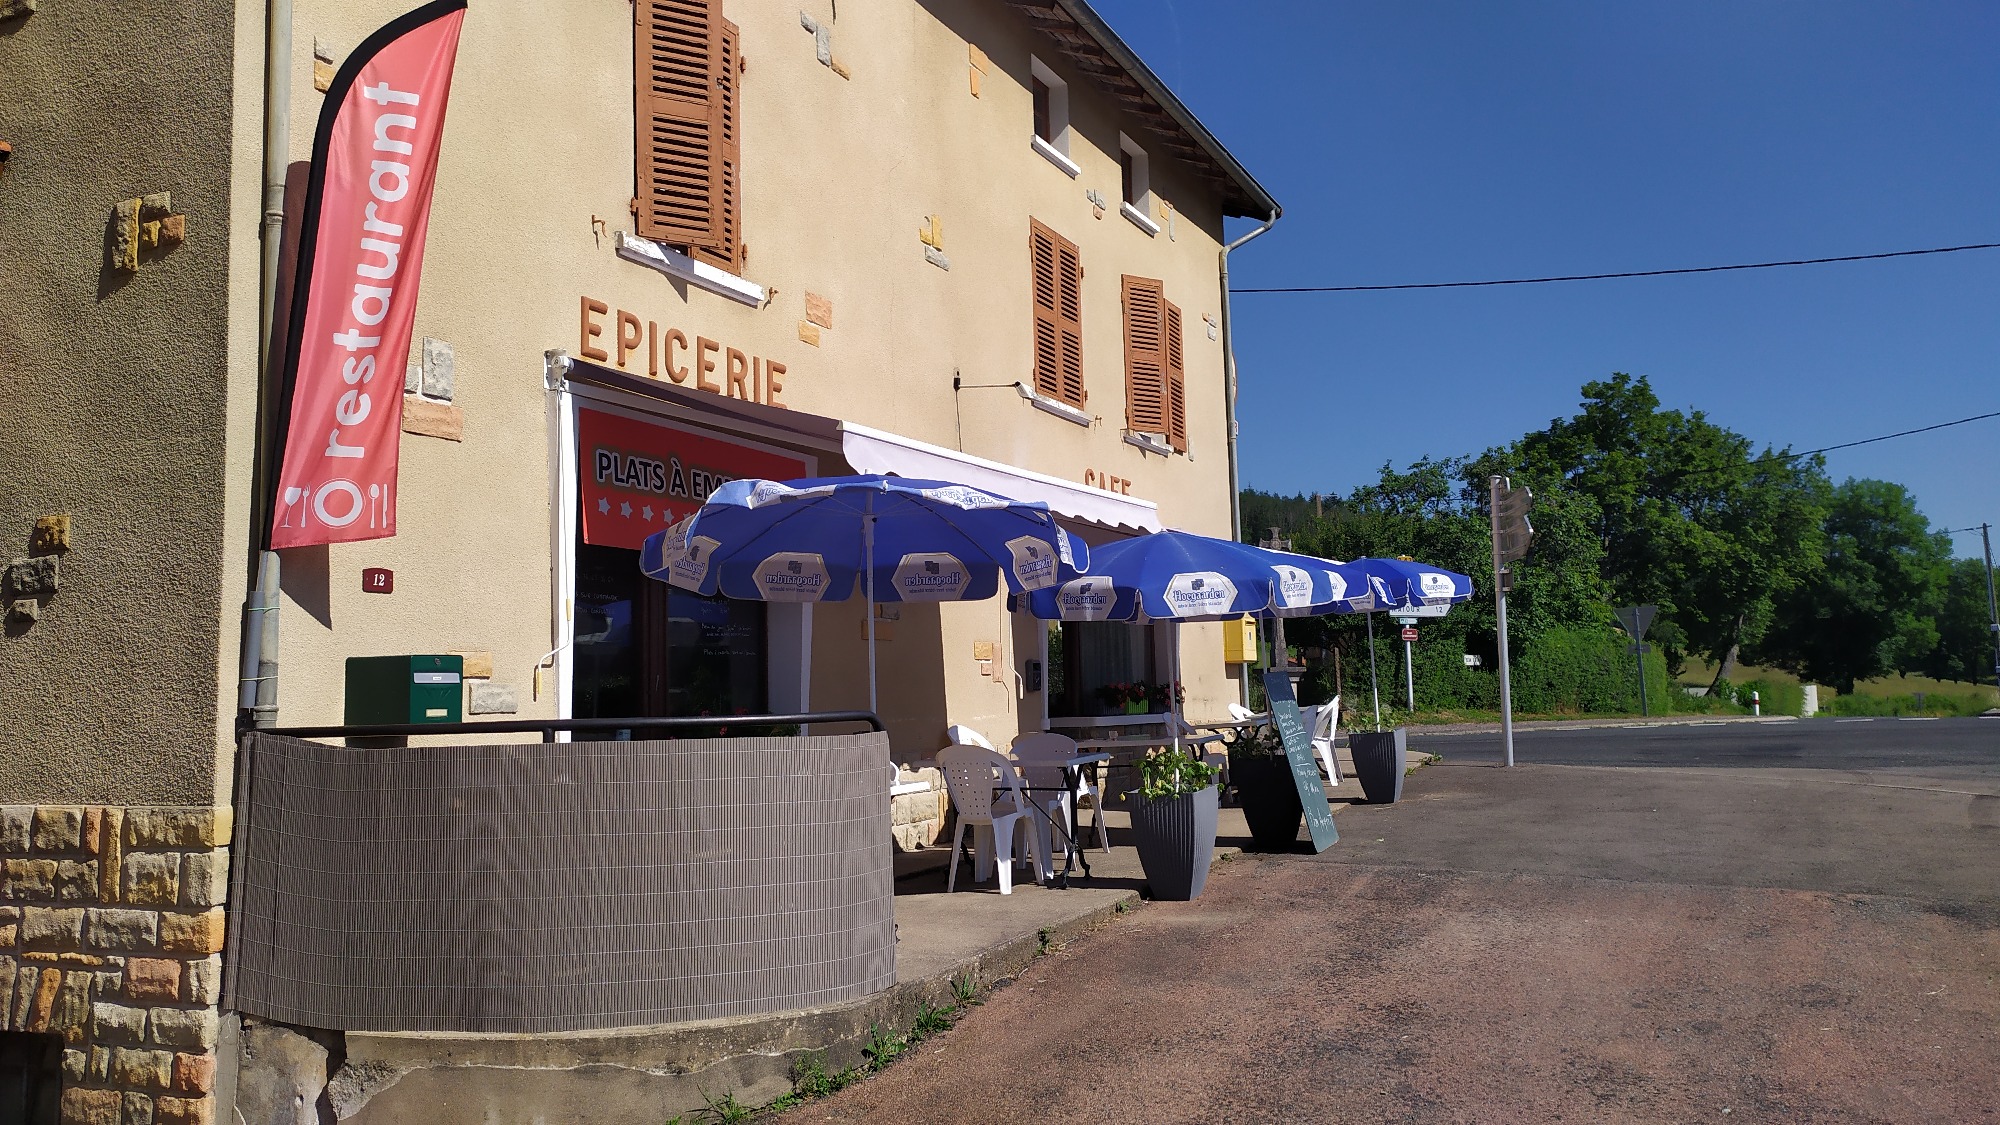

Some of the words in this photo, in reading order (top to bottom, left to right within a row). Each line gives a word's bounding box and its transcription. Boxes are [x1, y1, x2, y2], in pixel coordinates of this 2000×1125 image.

[324, 81, 420, 458] restaurant
[580, 295, 787, 409] EPICERIE
[597, 450, 666, 492] PLATS
[670, 457, 688, 497] À
[691, 469, 735, 500] EM
[372, 573, 385, 587] 12
[1173, 588, 1225, 602] Hoegaarden
[1063, 593, 1107, 606] Hoegaarden
